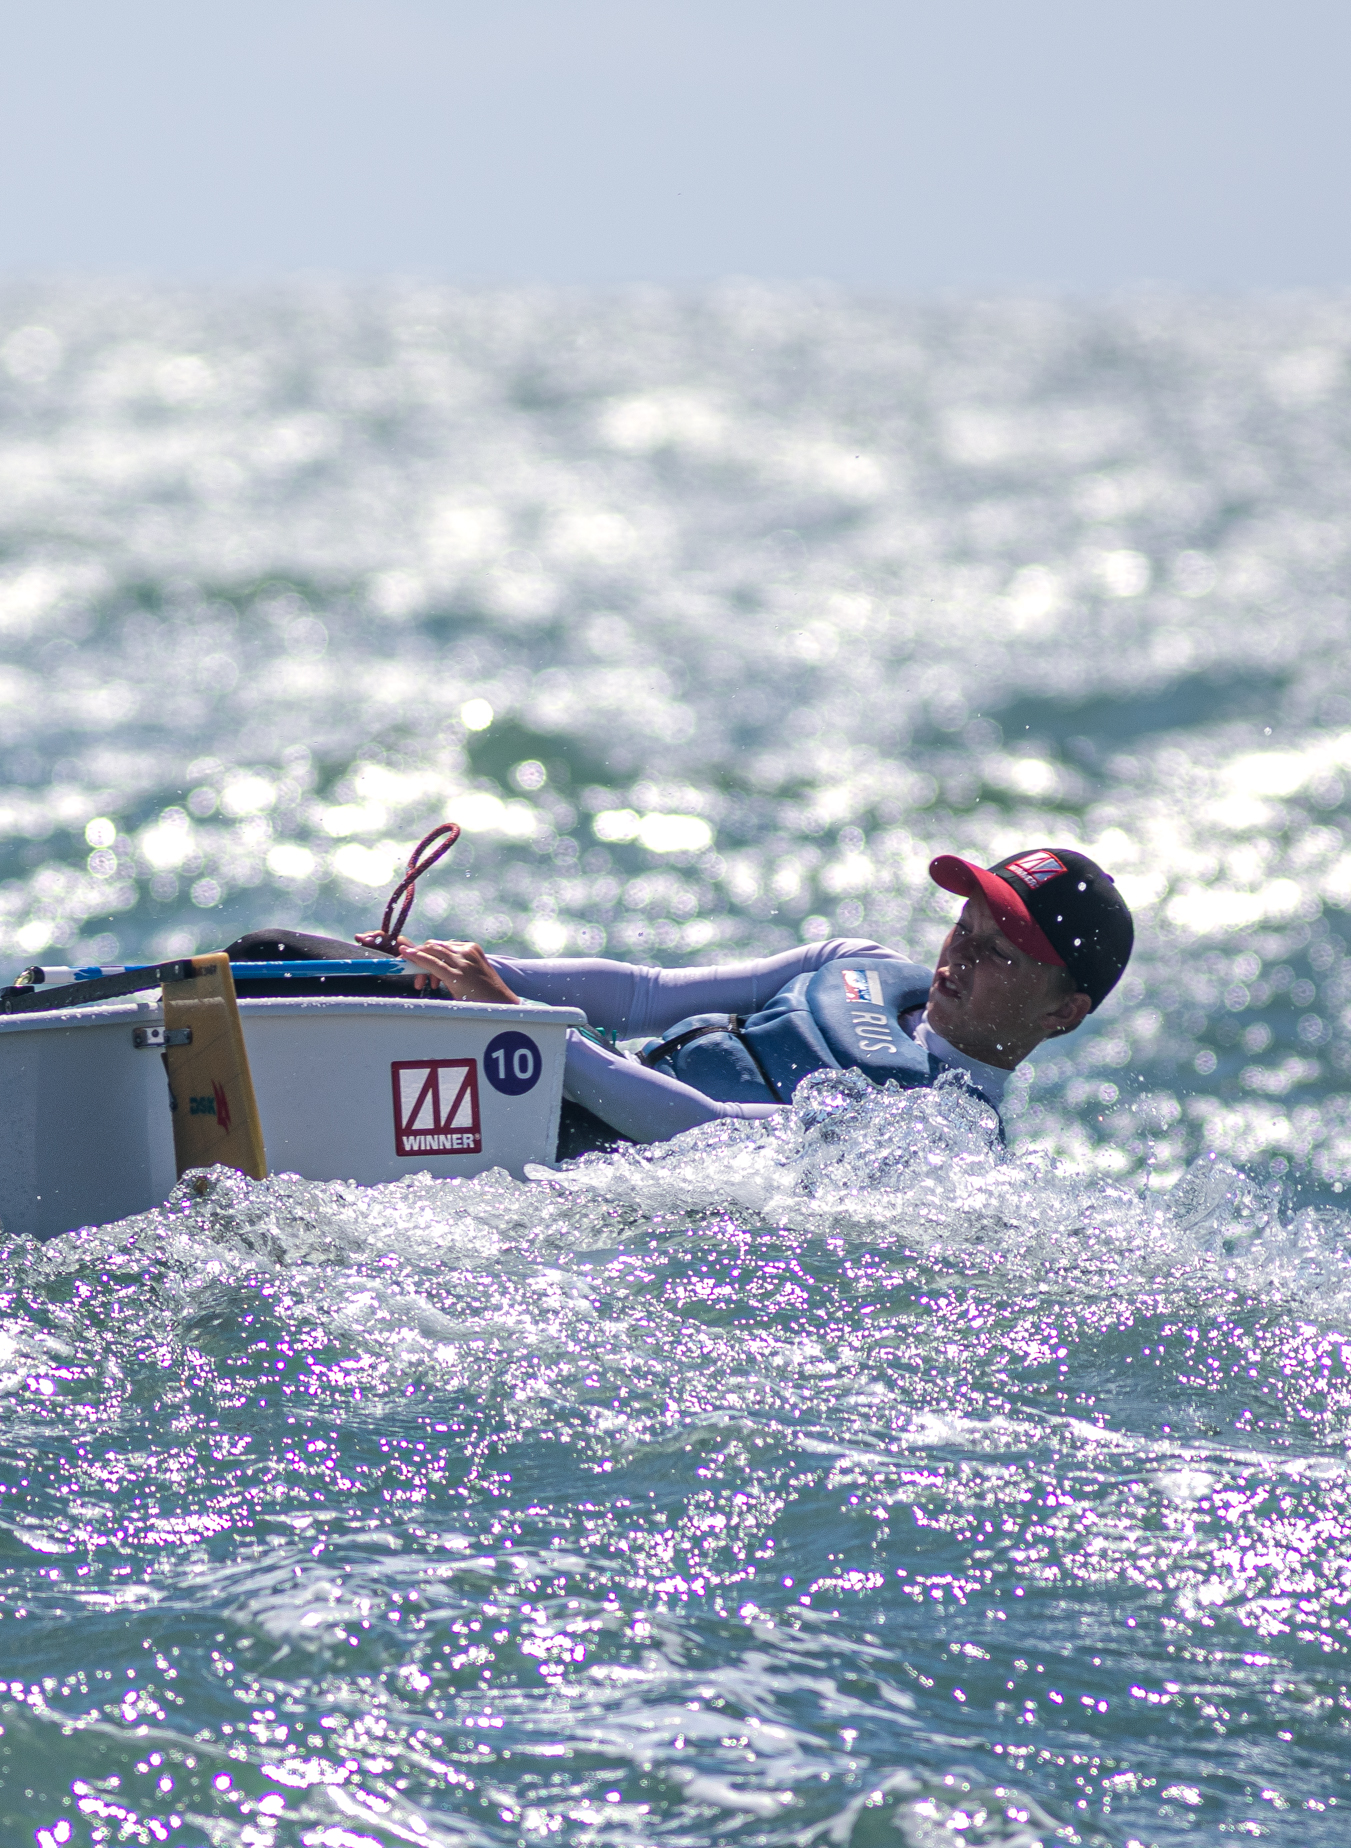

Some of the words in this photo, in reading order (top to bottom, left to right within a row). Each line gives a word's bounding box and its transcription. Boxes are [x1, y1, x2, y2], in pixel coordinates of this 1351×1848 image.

[850, 1010, 898, 1054] RUS
[491, 1048, 535, 1080] 10
[402, 1133, 475, 1151] WINNER
